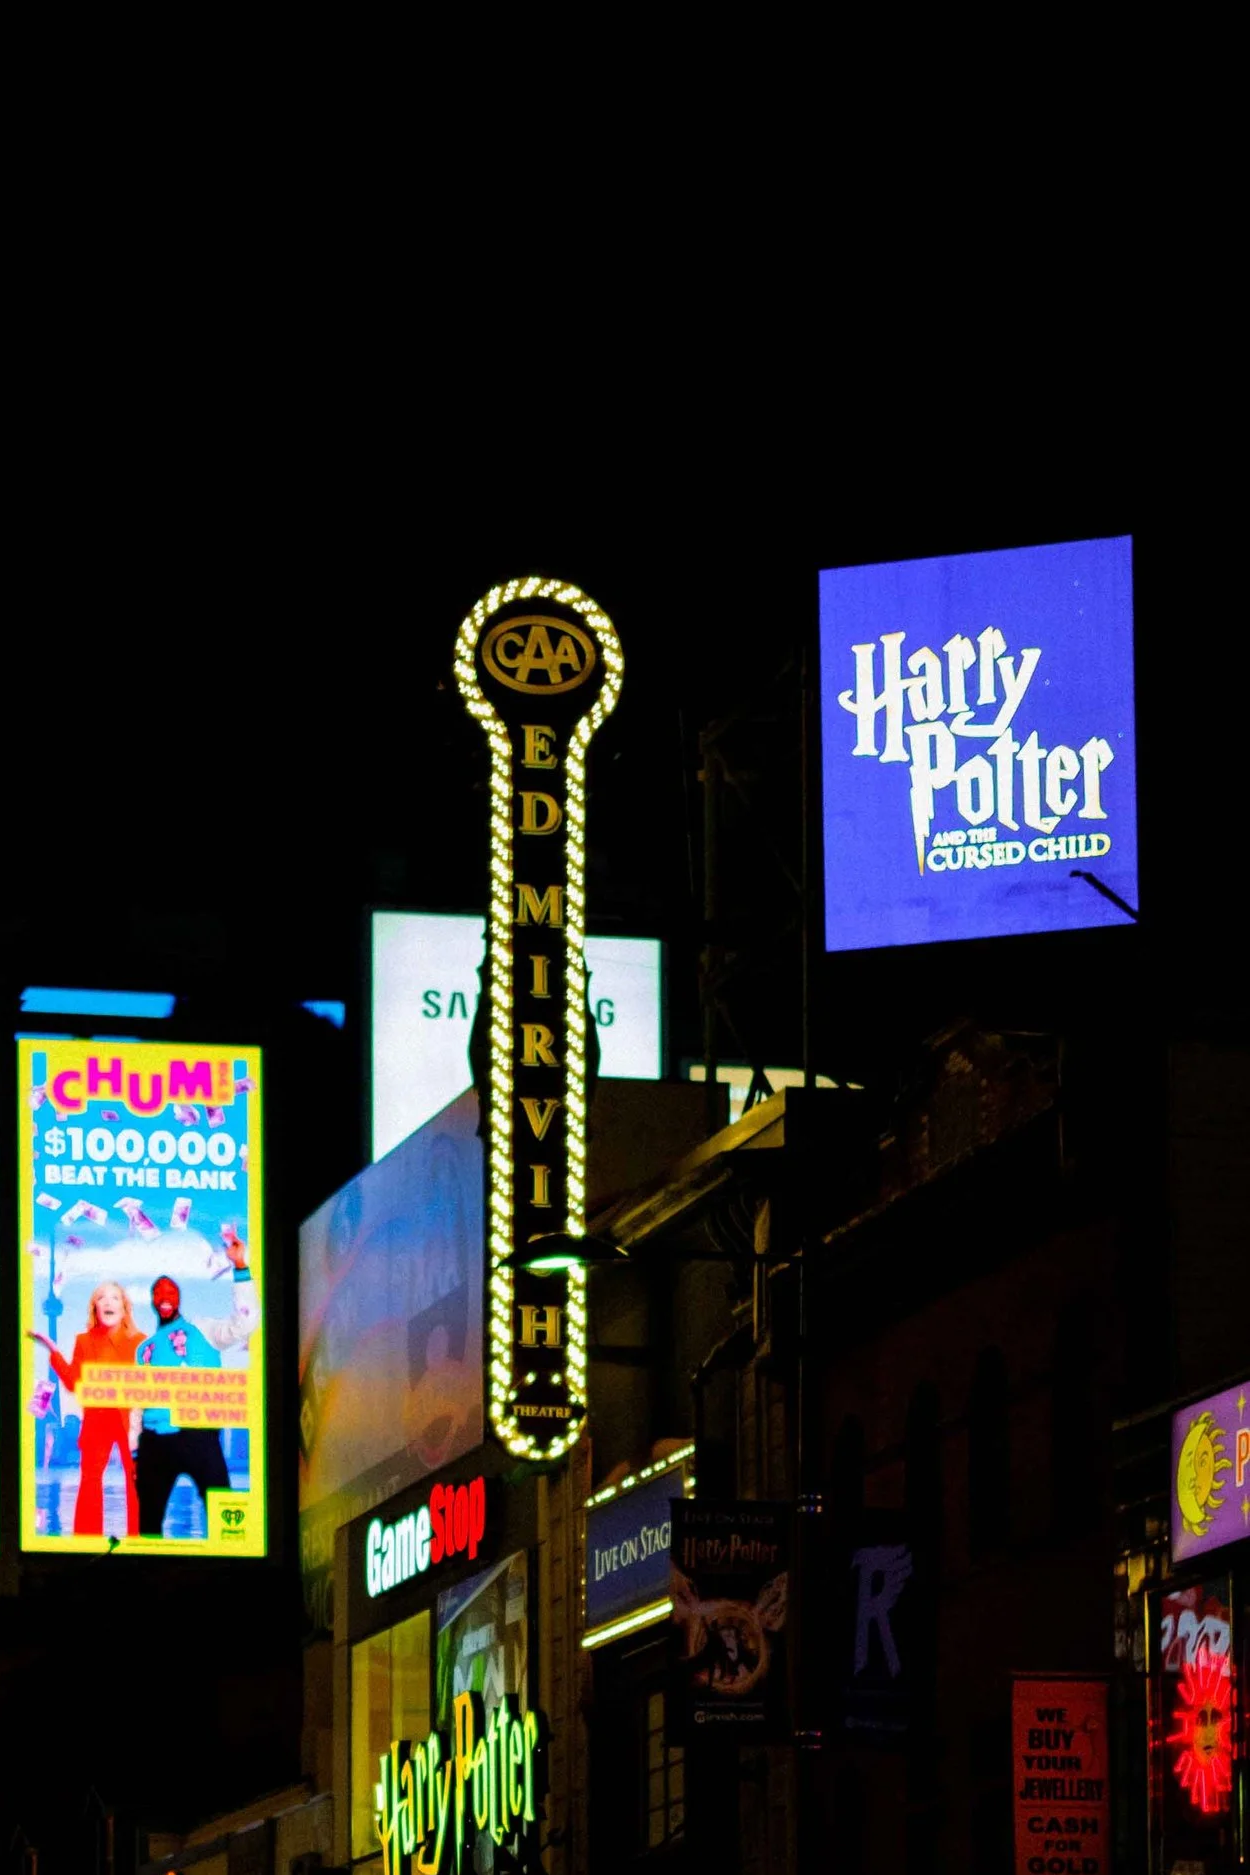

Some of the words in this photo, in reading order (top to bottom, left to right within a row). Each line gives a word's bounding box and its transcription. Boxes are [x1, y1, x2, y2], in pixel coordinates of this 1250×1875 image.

[494, 625, 588, 685] CAA
[838, 626, 1042, 763] Harry
[904, 721, 1115, 876] Potter
[932, 828, 966, 847] AND
[967, 826, 997, 844] THE
[926, 840, 1026, 872] CURSED
[1028, 833, 1112, 863] CHILD
[52, 1057, 213, 1114] CHUM
[514, 882, 565, 1348] MIRVIH
[44, 1126, 236, 1167] $100,000
[44, 1164, 108, 1186] BEAT
[112, 1167, 160, 1188] THE
[165, 1169, 237, 1191] BANK
[88, 1370, 146, 1383] LISTEN
[152, 1371, 247, 1386] WEEKDAYS
[82, 1387, 117, 1400] FOR
[122, 1389, 171, 1402] YOUR
[175, 1390, 247, 1404] CHANCE
[178, 1408, 200, 1421] TO
[366, 1475, 486, 1599] GameStop
[594, 1547, 618, 1582] LIVE
[619, 1537, 639, 1567] ON
[682, 1536, 727, 1569] Harry
[729, 1533, 779, 1570] Potter
[1036, 1708, 1068, 1722] WE
[1028, 1728, 1075, 1750] BUY
[1022, 1755, 1082, 1771] YOUR
[1020, 1777, 1104, 1801] JEWELLERY
[1027, 1816, 1099, 1835] CASH
[1044, 1839, 1082, 1852] FOR
[1027, 1856, 1099, 1875] GOLD
